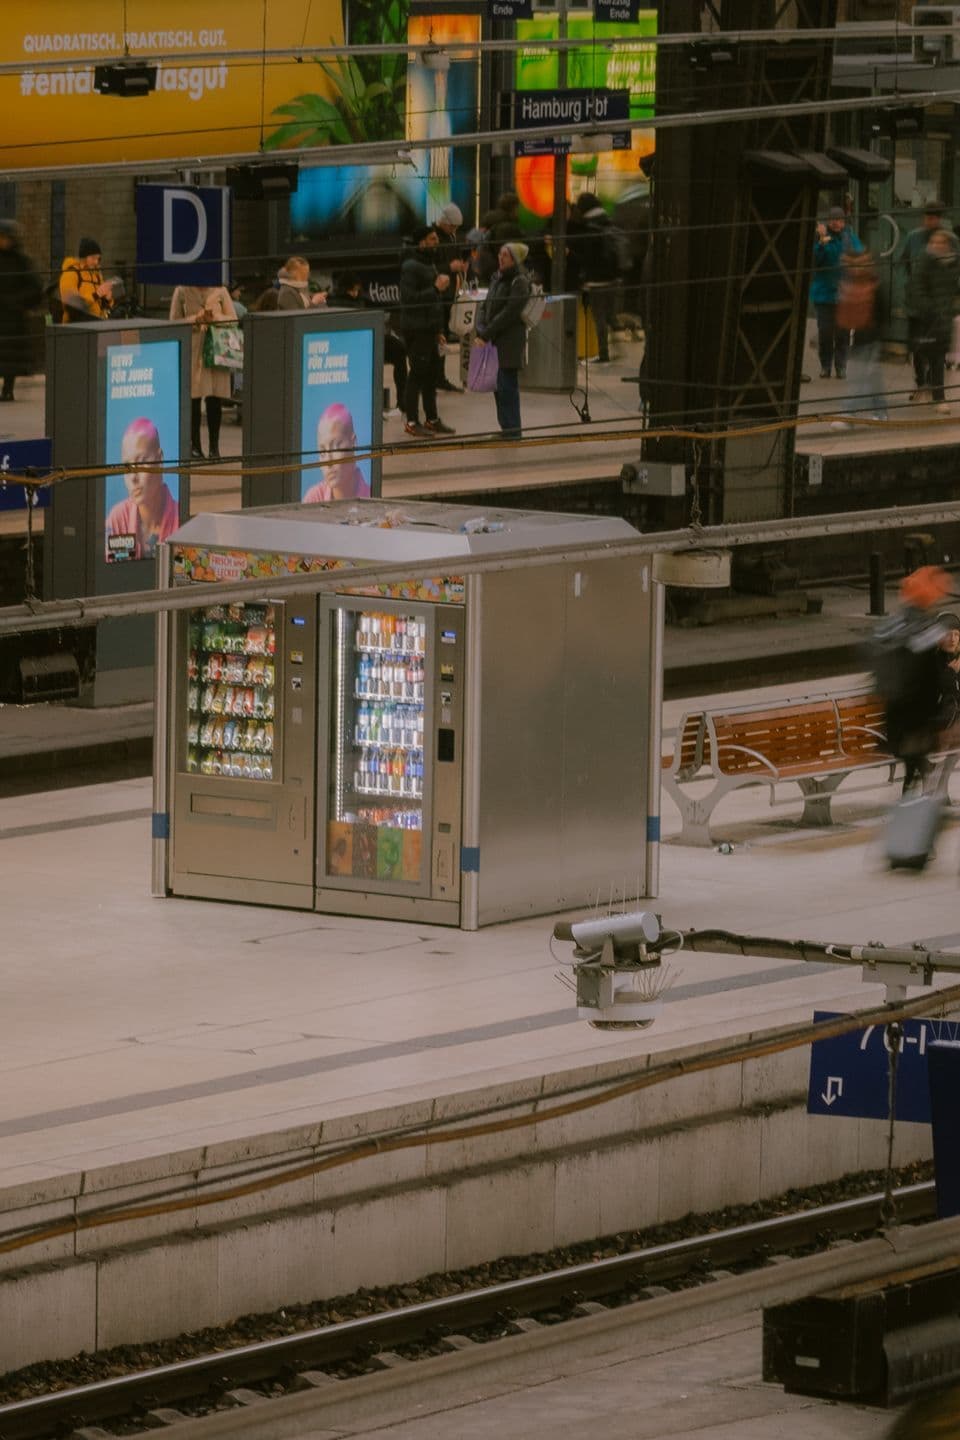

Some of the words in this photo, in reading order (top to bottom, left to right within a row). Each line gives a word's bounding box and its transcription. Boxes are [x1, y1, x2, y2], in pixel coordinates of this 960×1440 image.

[23, 33, 121, 52] QUADRATISCH.
[124, 30, 197, 49] PRAKTISCH.
[198, 28, 227, 46] GUT.
[522, 98, 582, 122] Hamburg
[163, 188, 208, 263] D
